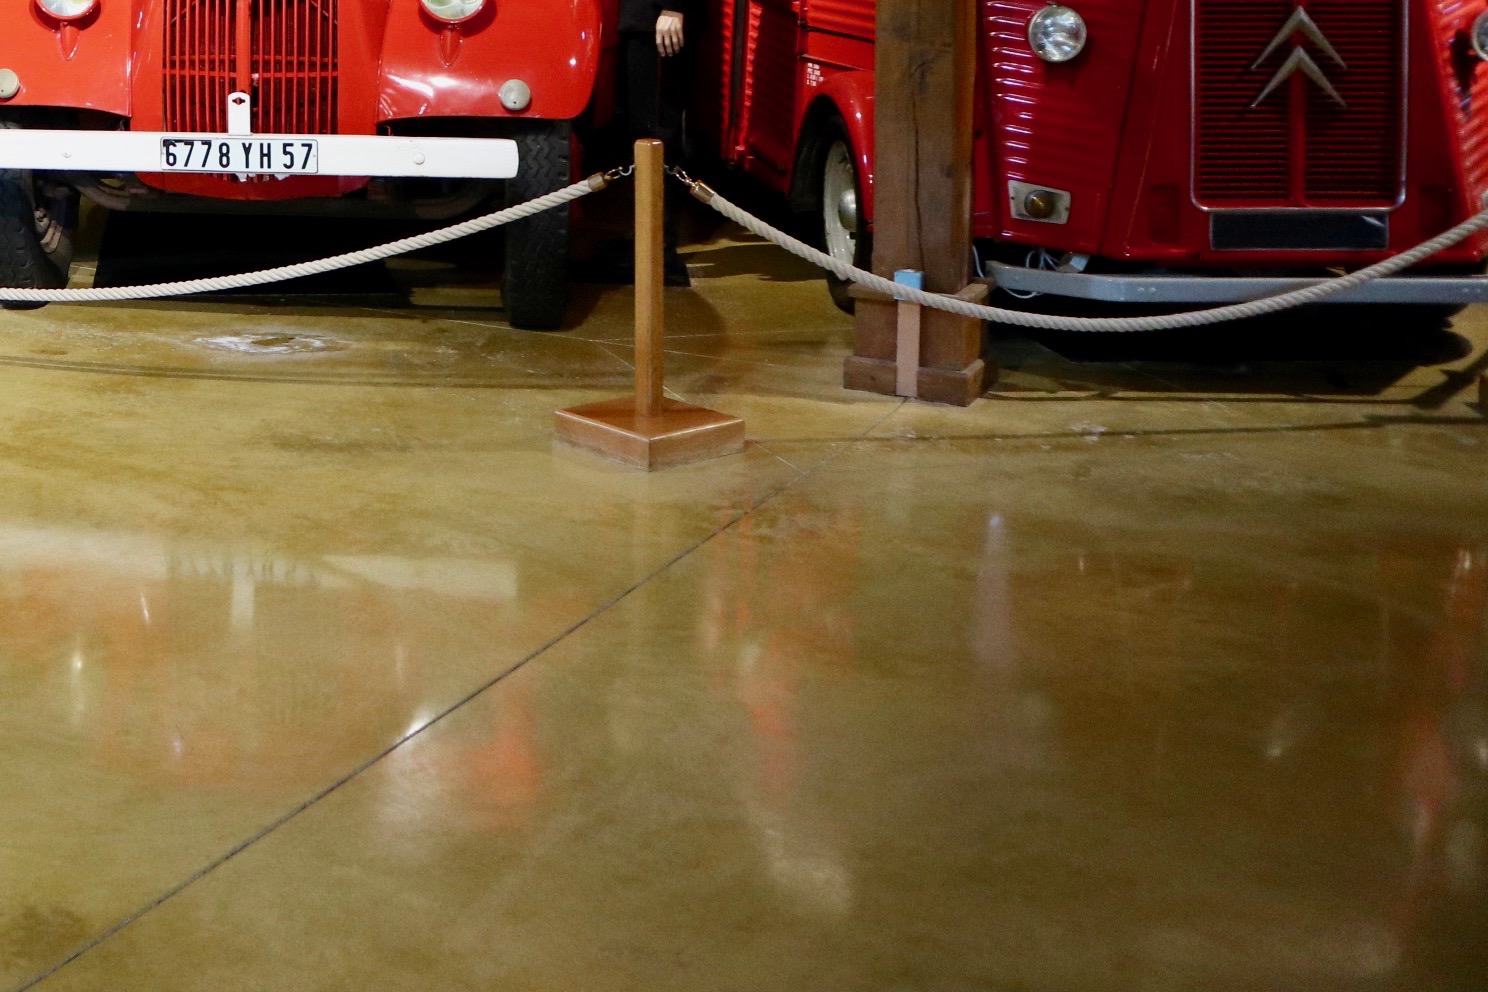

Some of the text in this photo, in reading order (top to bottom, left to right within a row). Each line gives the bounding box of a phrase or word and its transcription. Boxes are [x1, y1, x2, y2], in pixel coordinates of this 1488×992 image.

[163, 140, 313, 170] 6778 YH 57
